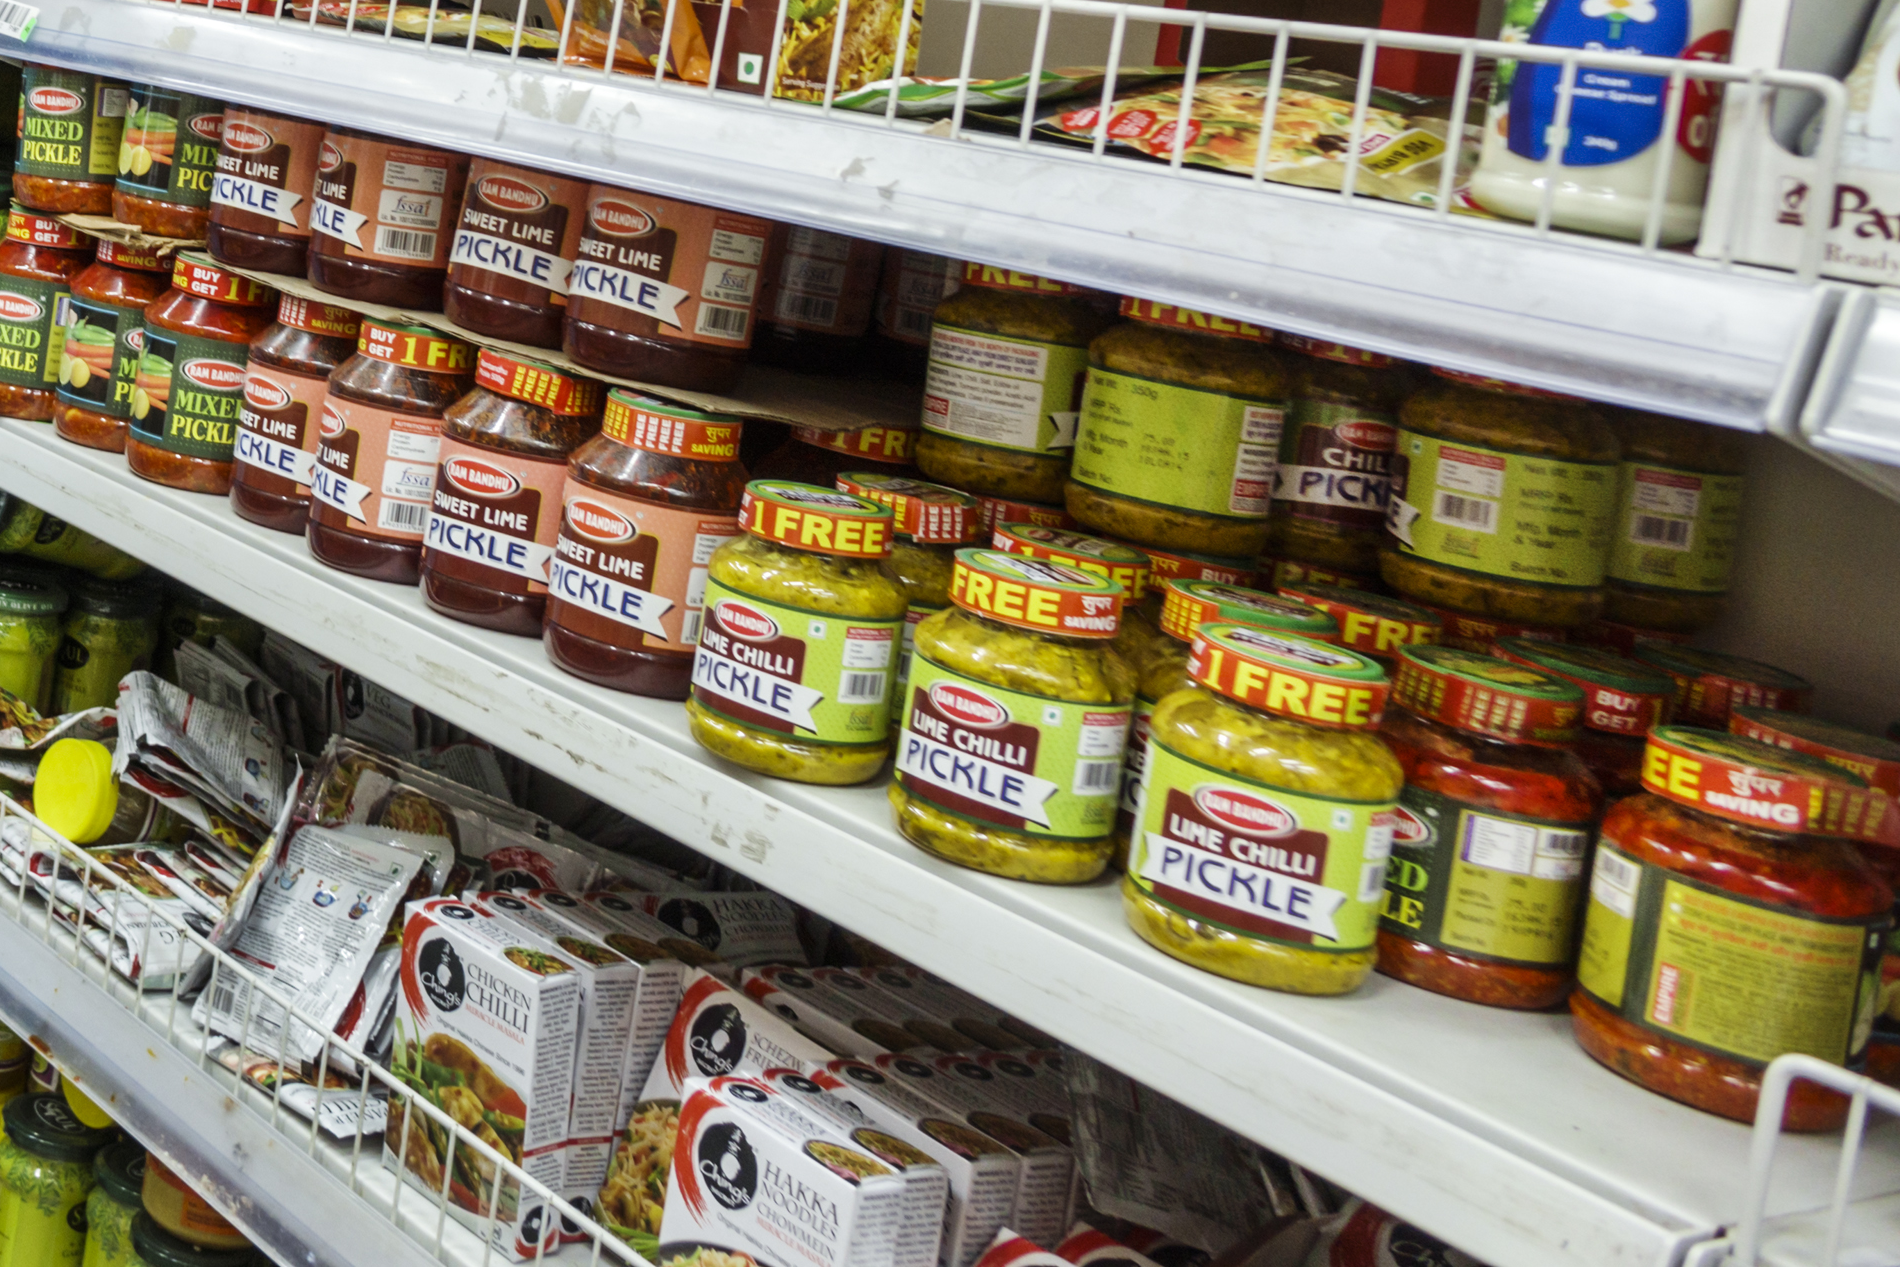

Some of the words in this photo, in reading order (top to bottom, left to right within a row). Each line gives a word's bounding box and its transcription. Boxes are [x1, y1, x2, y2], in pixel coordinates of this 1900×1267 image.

[1555, 84, 1604, 101] Ceese
[1606, 85, 1656, 106] Spread
[1583, 72, 1630, 90] Cream
[25, 117, 84, 142] MIXED
[23, 142, 82, 166] PICKLE
[244, 160, 280, 181] LIME
[322, 183, 347, 200] LIME
[501, 184, 540, 207] BANDHU
[34, 232, 60, 244] GET
[35, 219, 61, 232] BUY
[464, 207, 508, 237] SWEET
[511, 217, 554, 246] LIME
[116, 254, 157, 268] SAVING
[456, 237, 552, 283] PICKLE
[581, 238, 617, 265] SWEET
[621, 246, 662, 272] LIME
[1825, 242, 1900, 274] Ready
[191, 280, 219, 296] GET
[193, 267, 220, 283] BUY
[224, 274, 241, 301] 1
[573, 265, 660, 313] PICKLE
[3, 297, 37, 318] BANDHU
[311, 317, 358, 335] SAVING
[368, 340, 394, 358] GET
[371, 328, 397, 344] BUY
[402, 336, 419, 365] 1
[210, 368, 246, 388] BANDHU
[262, 417, 297, 440] LIME
[705, 425, 732, 442] सुपर
[322, 447, 350, 469] LIME
[691, 442, 734, 457] SAVING
[469, 467, 512, 491] BANDHU
[435, 489, 480, 521] SWEET
[483, 501, 528, 531] LIME
[591, 507, 630, 534] BANDHU
[752, 500, 768, 535] 1
[773, 505, 885, 555] FREE
[429, 519, 527, 570] PICKLE
[558, 533, 596, 565] SWEET
[599, 545, 645, 580] LIME
[1201, 568, 1237, 585] BUY
[551, 563, 645, 622] PICKLE
[951, 564, 1061, 627] FREE
[1081, 595, 1113, 615] सुपर
[734, 608, 774, 632] BANDHU
[1063, 614, 1117, 633] SAVING
[702, 626, 731, 660] LIME
[733, 636, 795, 675] CHILLI
[366, 684, 393, 704] VEG
[698, 652, 794, 714] PICKLE
[1205, 646, 1223, 691] 1
[1231, 658, 1371, 727] FREE
[955, 696, 1003, 722] BANDHU
[1595, 689, 1642, 710] BUY
[1593, 708, 1639, 731] GET
[912, 709, 948, 745] LIME
[952, 722, 1027, 767] CHILLI
[907, 736, 1026, 808] PICKLE
[1728, 767, 1783, 795] सुपर
[1232, 796, 1289, 826] BANDHU
[1705, 790, 1800, 825] SAVING
[1170, 812, 1221, 852] LIME
[1224, 830, 1317, 875] CHILLI
[1161, 843, 1313, 921] PICKLE
[714, 895, 783, 913] HAKKA
[717, 908, 790, 924] NOODLES
[421, 969, 463, 1008] Ching's
[467, 962, 532, 1013] CHICKEN
[1655, 964, 1680, 1025] EMPIRE
[464, 981, 529, 1036] CHILLI
[691, 1038, 734, 1075] Ching's
[700, 1164, 753, 1206] Ching's
[762, 1161, 839, 1219] HAKKA
[758, 1181, 837, 1240] NOODLES
[756, 1200, 837, 1262] CHOWMEIN
